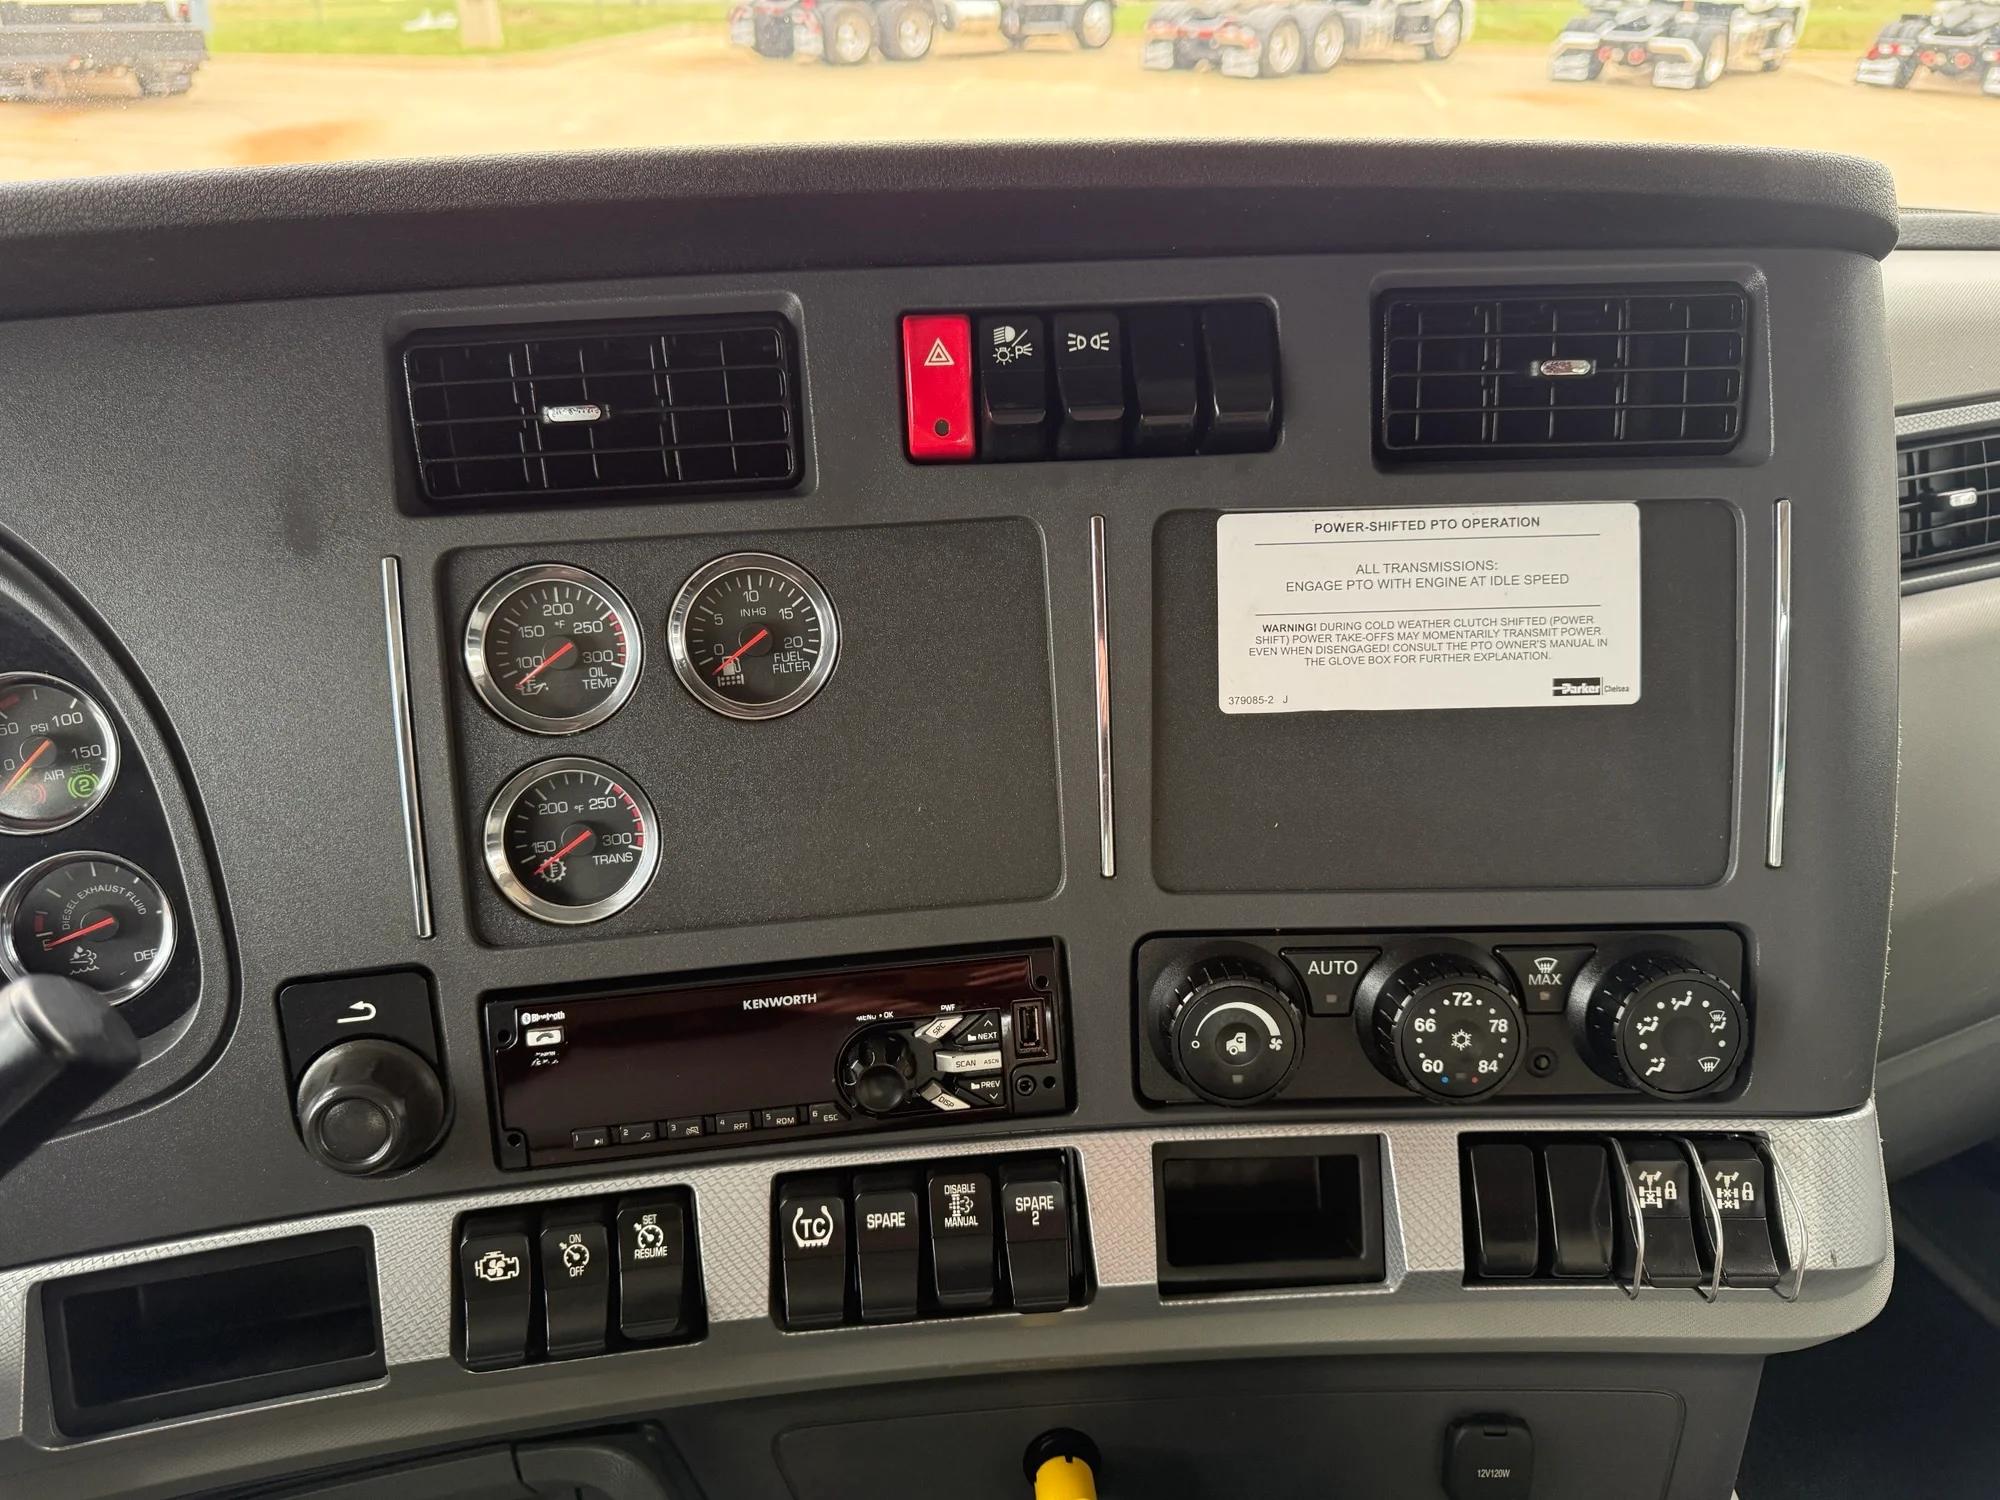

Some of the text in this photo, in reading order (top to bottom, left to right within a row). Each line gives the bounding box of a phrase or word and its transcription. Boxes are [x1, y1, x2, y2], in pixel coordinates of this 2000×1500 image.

[1314, 516, 1540, 534] POWER-SHIFTED PTO OPERATION
[1356, 560, 1498, 575] ALL TRANSMISSIONS:
[1286, 573, 1569, 592] ENGAGE PTO WITH ENGINE AT IDLE SPEED
[743, 590, 759, 602] 10
[543, 603, 574, 616] 200
[778, 608, 794, 620] 15
[714, 614, 724, 625] 5
[1262, 615, 1594, 633] WARNING! DURING COLD WEATHER CLUTCH SHIFTED (POWER
[518, 625, 545, 638] 150
[573, 620, 603, 634] 250
[784, 636, 804, 648] 20
[1255, 626, 1601, 645] SHIFT) POWER TAKE-OFFS MAY MOMENTARILY TRANSMIT POWER
[714, 643, 724, 655] 0
[1249, 638, 1608, 656] EVEN WHEN DISENGAGED! CONSULT THE PTO OWNER'S MANUAL IN
[516, 655, 544, 669] 100
[583, 650, 614, 663] 300
[774, 652, 804, 664] FUEL
[1304, 651, 1551, 667] THE GLOVE BOX FOR FURTHER EXPLANATION.
[589, 667, 607, 678] OIL
[772, 661, 811, 674] FILTER
[582, 677, 618, 690] TEMP
[1562, 682, 1600, 695] Parker
[1604, 684, 1629, 693] Chelsea
[1228, 695, 1288, 705] 379085-2 J
[52, 712, 83, 727] 100
[31, 723, 49, 733] PSI
[71, 744, 102, 760] 150
[4, 759, 15, 771] 0
[71, 764, 91, 774] SEC
[44, 769, 65, 782] AIR
[538, 801, 569, 815] 200
[589, 796, 617, 811] 250
[602, 832, 632, 846] 300
[531, 841, 557, 853] 150
[592, 852, 633, 865] TRANS
[62, 884, 147, 930] DIESEL EXHAUST FLUID
[1308, 959, 1358, 976] AUTO
[1527, 972, 1562, 986] MAX
[742, 993, 817, 1010] KENWORTH
[1453, 992, 1472, 1007] 72
[884, 1011, 894, 1019] OK
[932, 1022, 945, 1035] SRC
[1415, 1018, 1436, 1033] 66
[1489, 1019, 1508, 1034] 78
[977, 1032, 997, 1040] NEXT
[956, 1060, 976, 1068] SCAN
[1422, 1059, 1443, 1074] 60
[1478, 1059, 1498, 1074] 84
[981, 1080, 1000, 1089] PREV
[938, 1096, 955, 1108] DISP
[766, 1113, 795, 1126] 5 RDM
[823, 1113, 838, 1122] ESC
[719, 1119, 748, 1131] 4 RPT
[943, 1183, 976, 1195] DISABLE
[1015, 1195, 1054, 1213] SPARE
[642, 1215, 658, 1226] SET
[866, 1212, 906, 1230] SPARE
[944, 1215, 979, 1228] MANUAL
[1031, 1212, 1040, 1226] 2
[801, 1219, 827, 1240] TC
[569, 1235, 582, 1245] ON
[634, 1246, 668, 1259] RESUME
[569, 1266, 585, 1278] OFF
[1477, 1469, 1511, 1479] 12V120W
